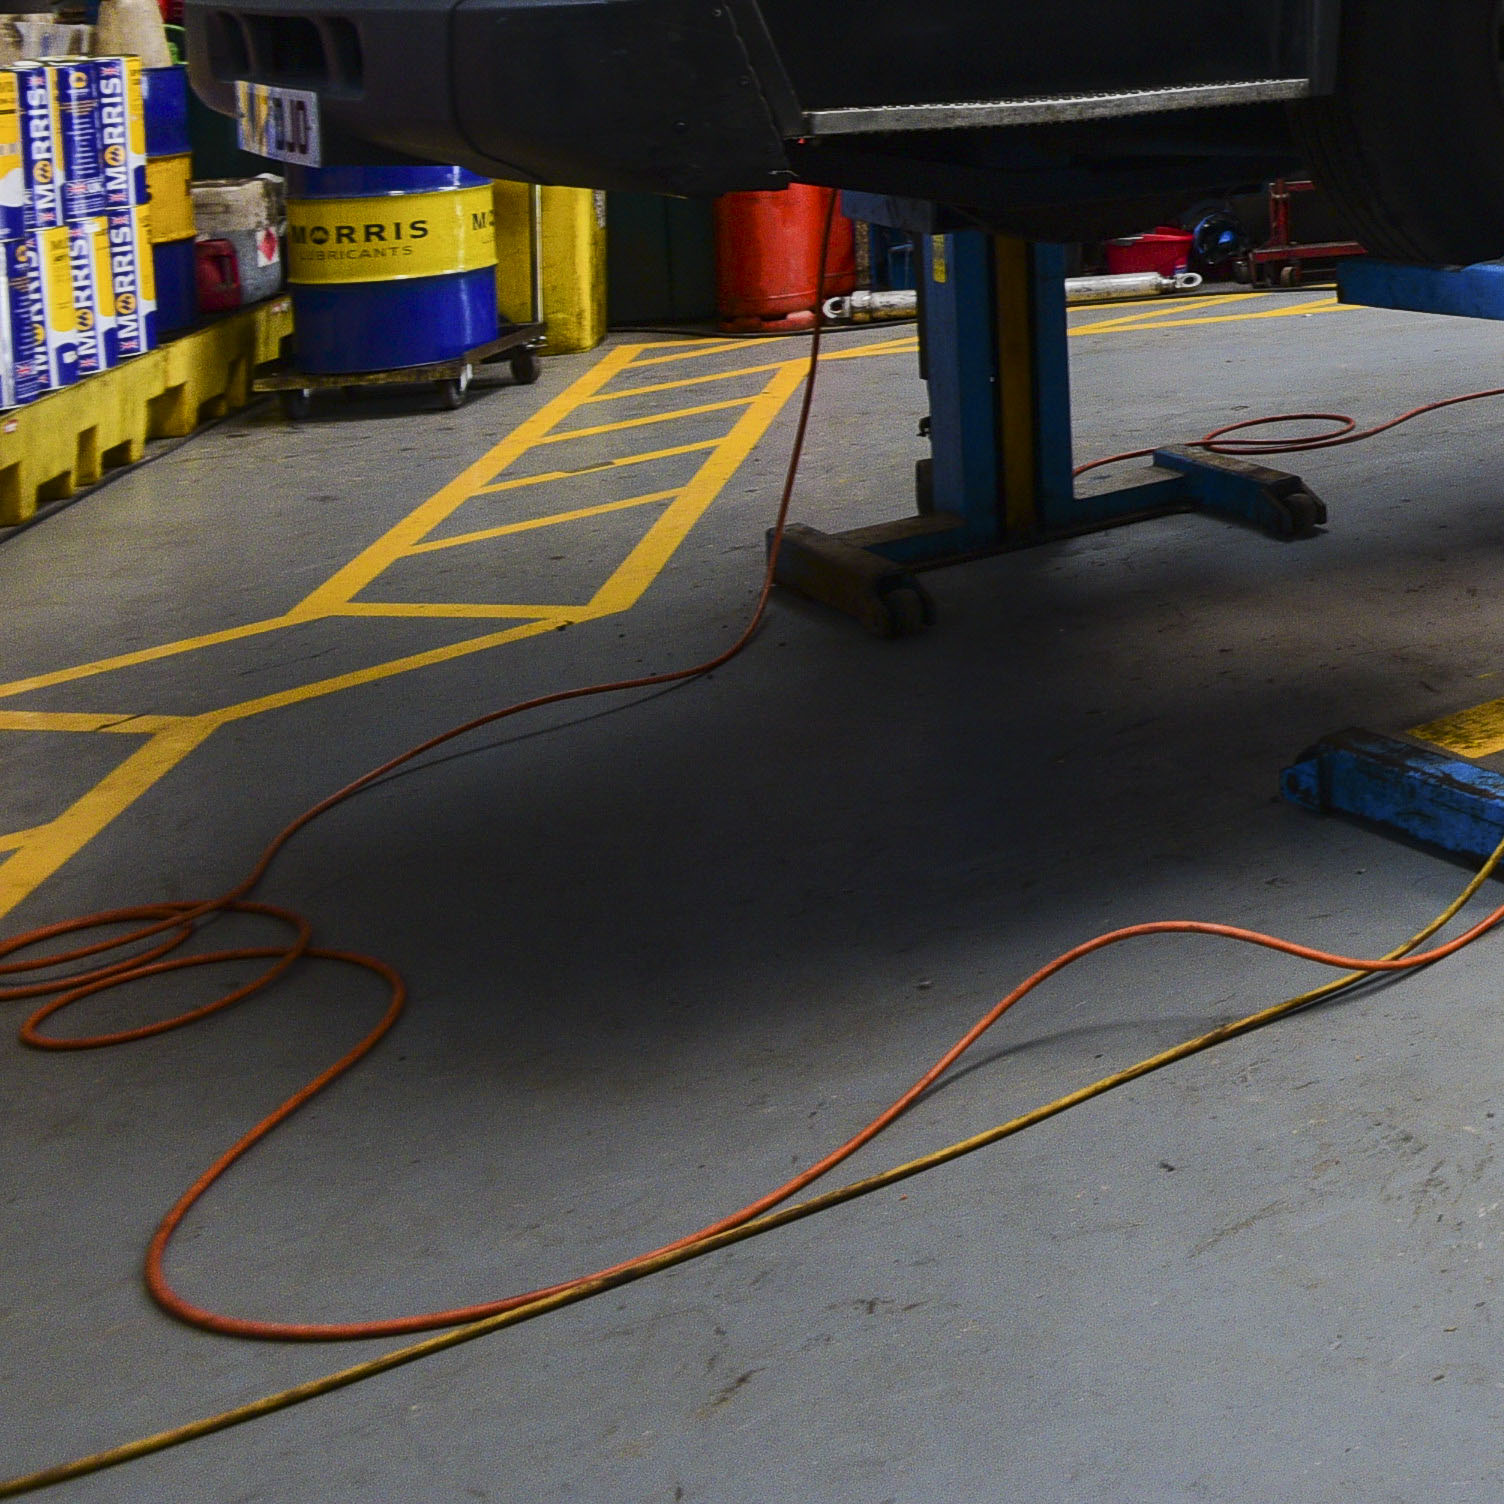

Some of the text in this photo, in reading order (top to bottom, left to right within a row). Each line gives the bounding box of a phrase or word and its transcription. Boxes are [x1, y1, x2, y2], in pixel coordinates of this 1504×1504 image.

[27, 88, 57, 210] MORRIS
[100, 77, 129, 190] MORRIS
[110, 226, 139, 339] MORRIS
[290, 219, 429, 246] MORRIS
[70, 238, 98, 355] MORRIS
